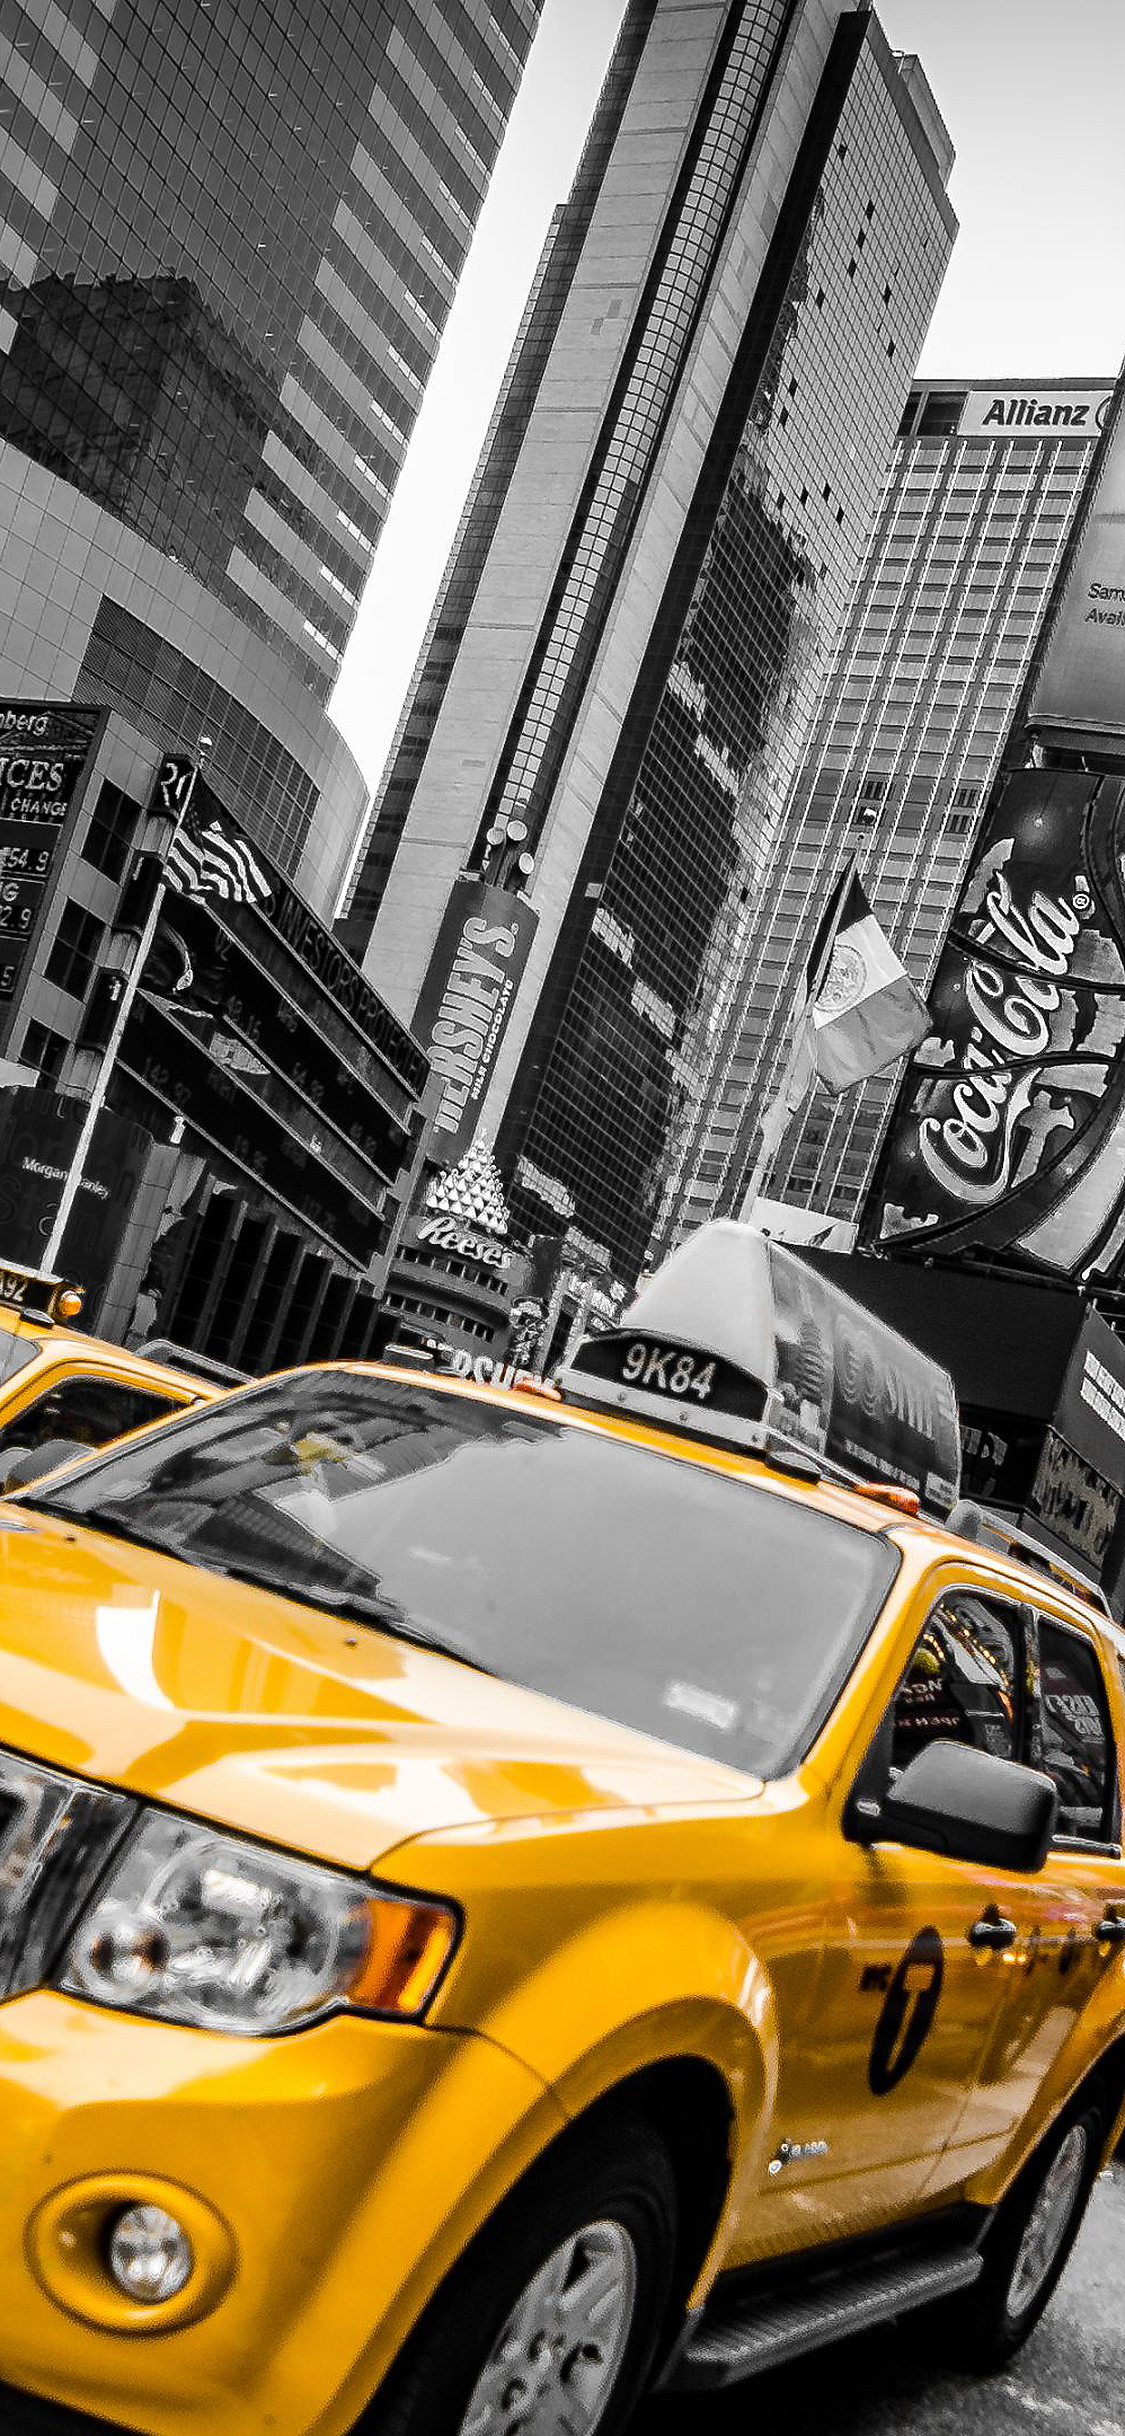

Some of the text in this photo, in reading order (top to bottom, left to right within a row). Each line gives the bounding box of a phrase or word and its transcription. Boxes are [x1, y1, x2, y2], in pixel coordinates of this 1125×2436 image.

[982, 398, 1091, 427] Allianz
[22, 1156, 109, 1200] Morgan anley
[621, 1343, 718, 1399] 9K84
